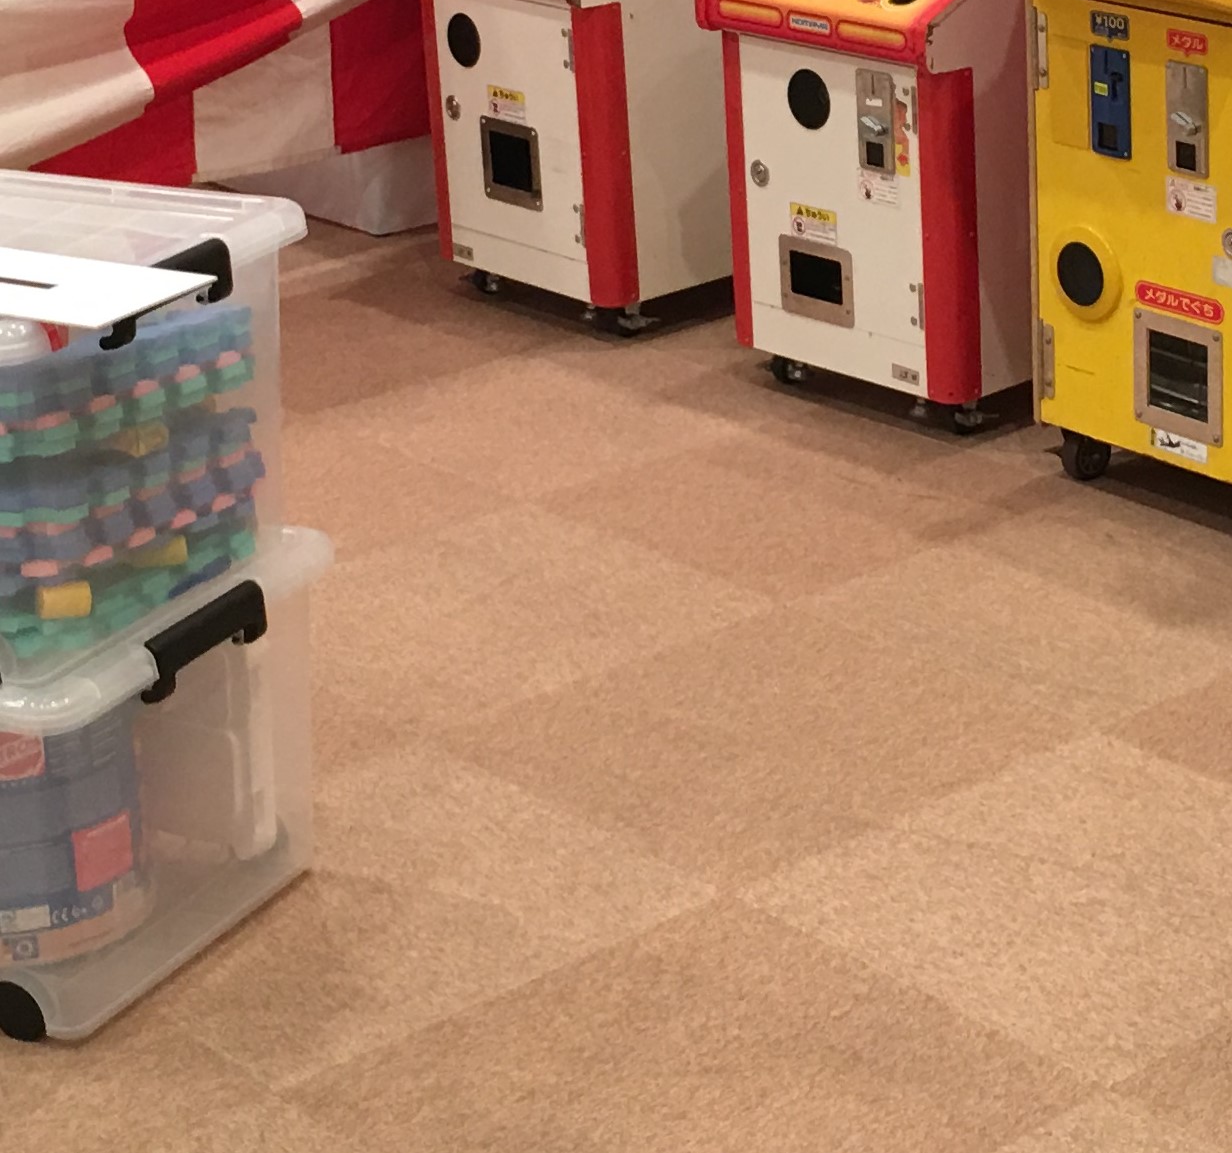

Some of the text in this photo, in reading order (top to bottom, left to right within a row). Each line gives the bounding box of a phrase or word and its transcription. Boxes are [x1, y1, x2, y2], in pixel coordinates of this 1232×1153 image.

[1171, 35, 1204, 51] メダル
[1144, 288, 1215, 318] メダルでぐち
